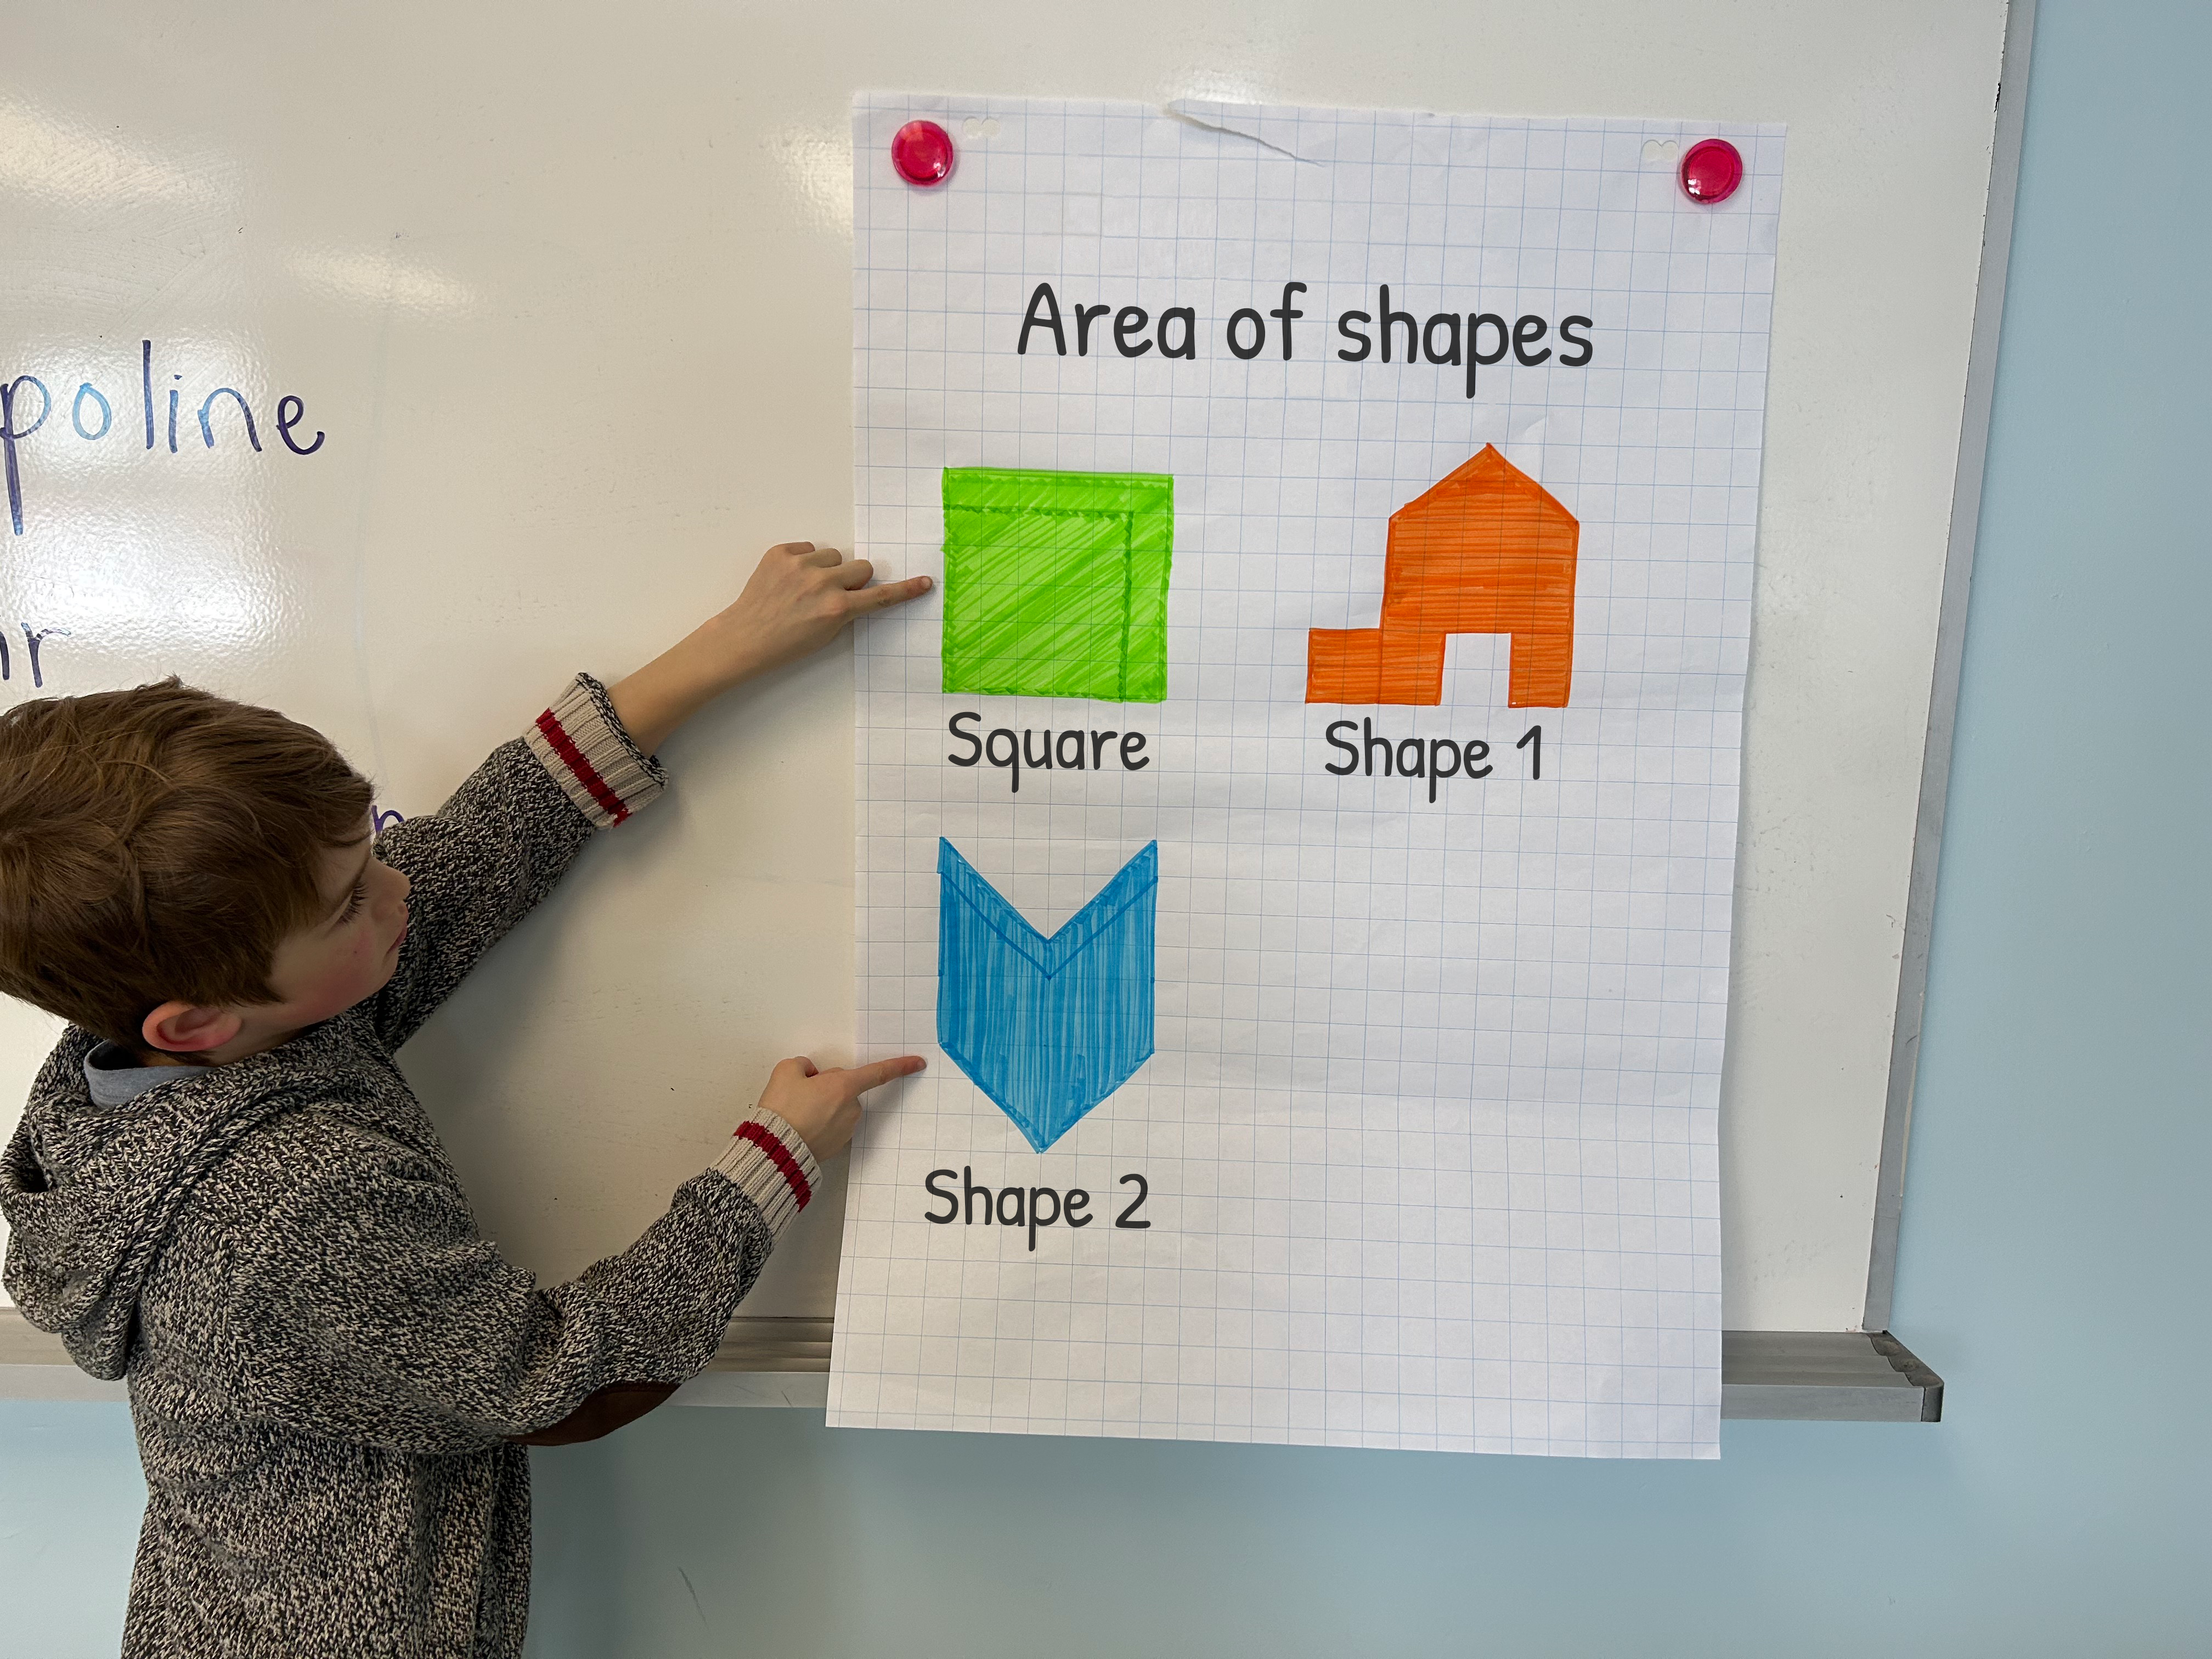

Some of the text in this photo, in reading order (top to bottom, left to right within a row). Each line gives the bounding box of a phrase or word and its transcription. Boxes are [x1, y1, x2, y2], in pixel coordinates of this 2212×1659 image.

[1017, 281, 1593, 399] Area of shapes
[0, 339, 325, 536] poline
[948, 712, 1150, 793] Square
[1325, 716, 1542, 804] Shape 1
[924, 1165, 1151, 1252] Shape 2
